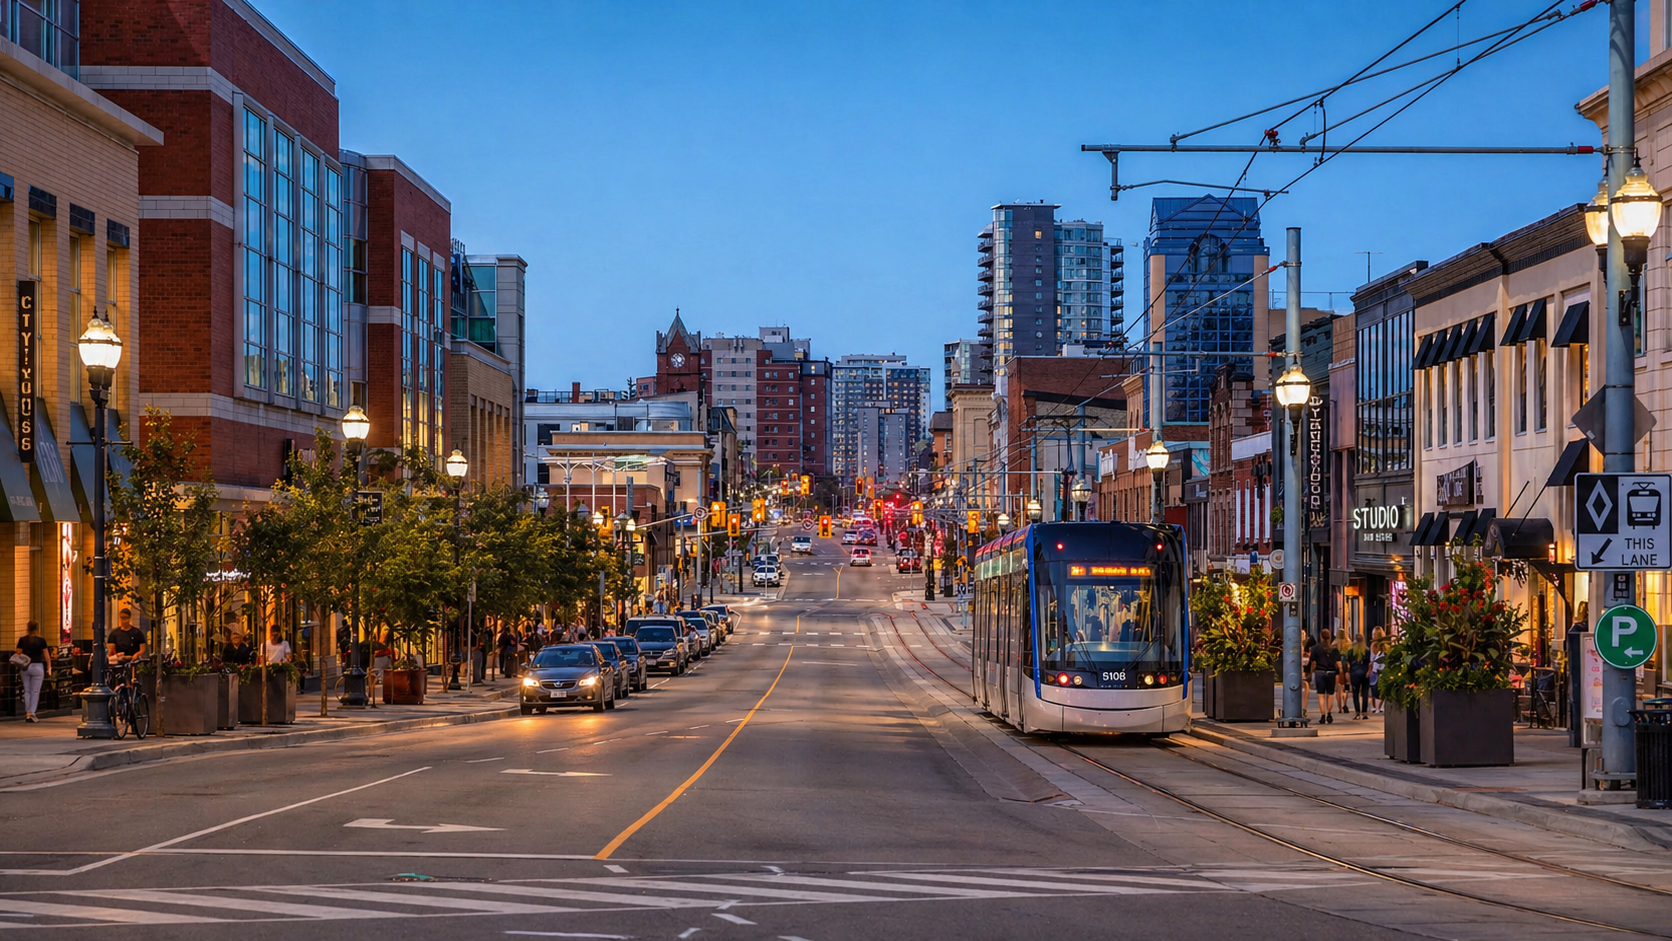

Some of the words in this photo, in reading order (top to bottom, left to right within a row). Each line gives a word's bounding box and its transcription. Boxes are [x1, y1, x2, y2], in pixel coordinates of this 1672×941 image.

[1353, 505, 1399, 529] STUDIO
[1624, 537, 1655, 550] THIS
[1621, 553, 1658, 566] LANE
[1611, 615, 1638, 647] P
